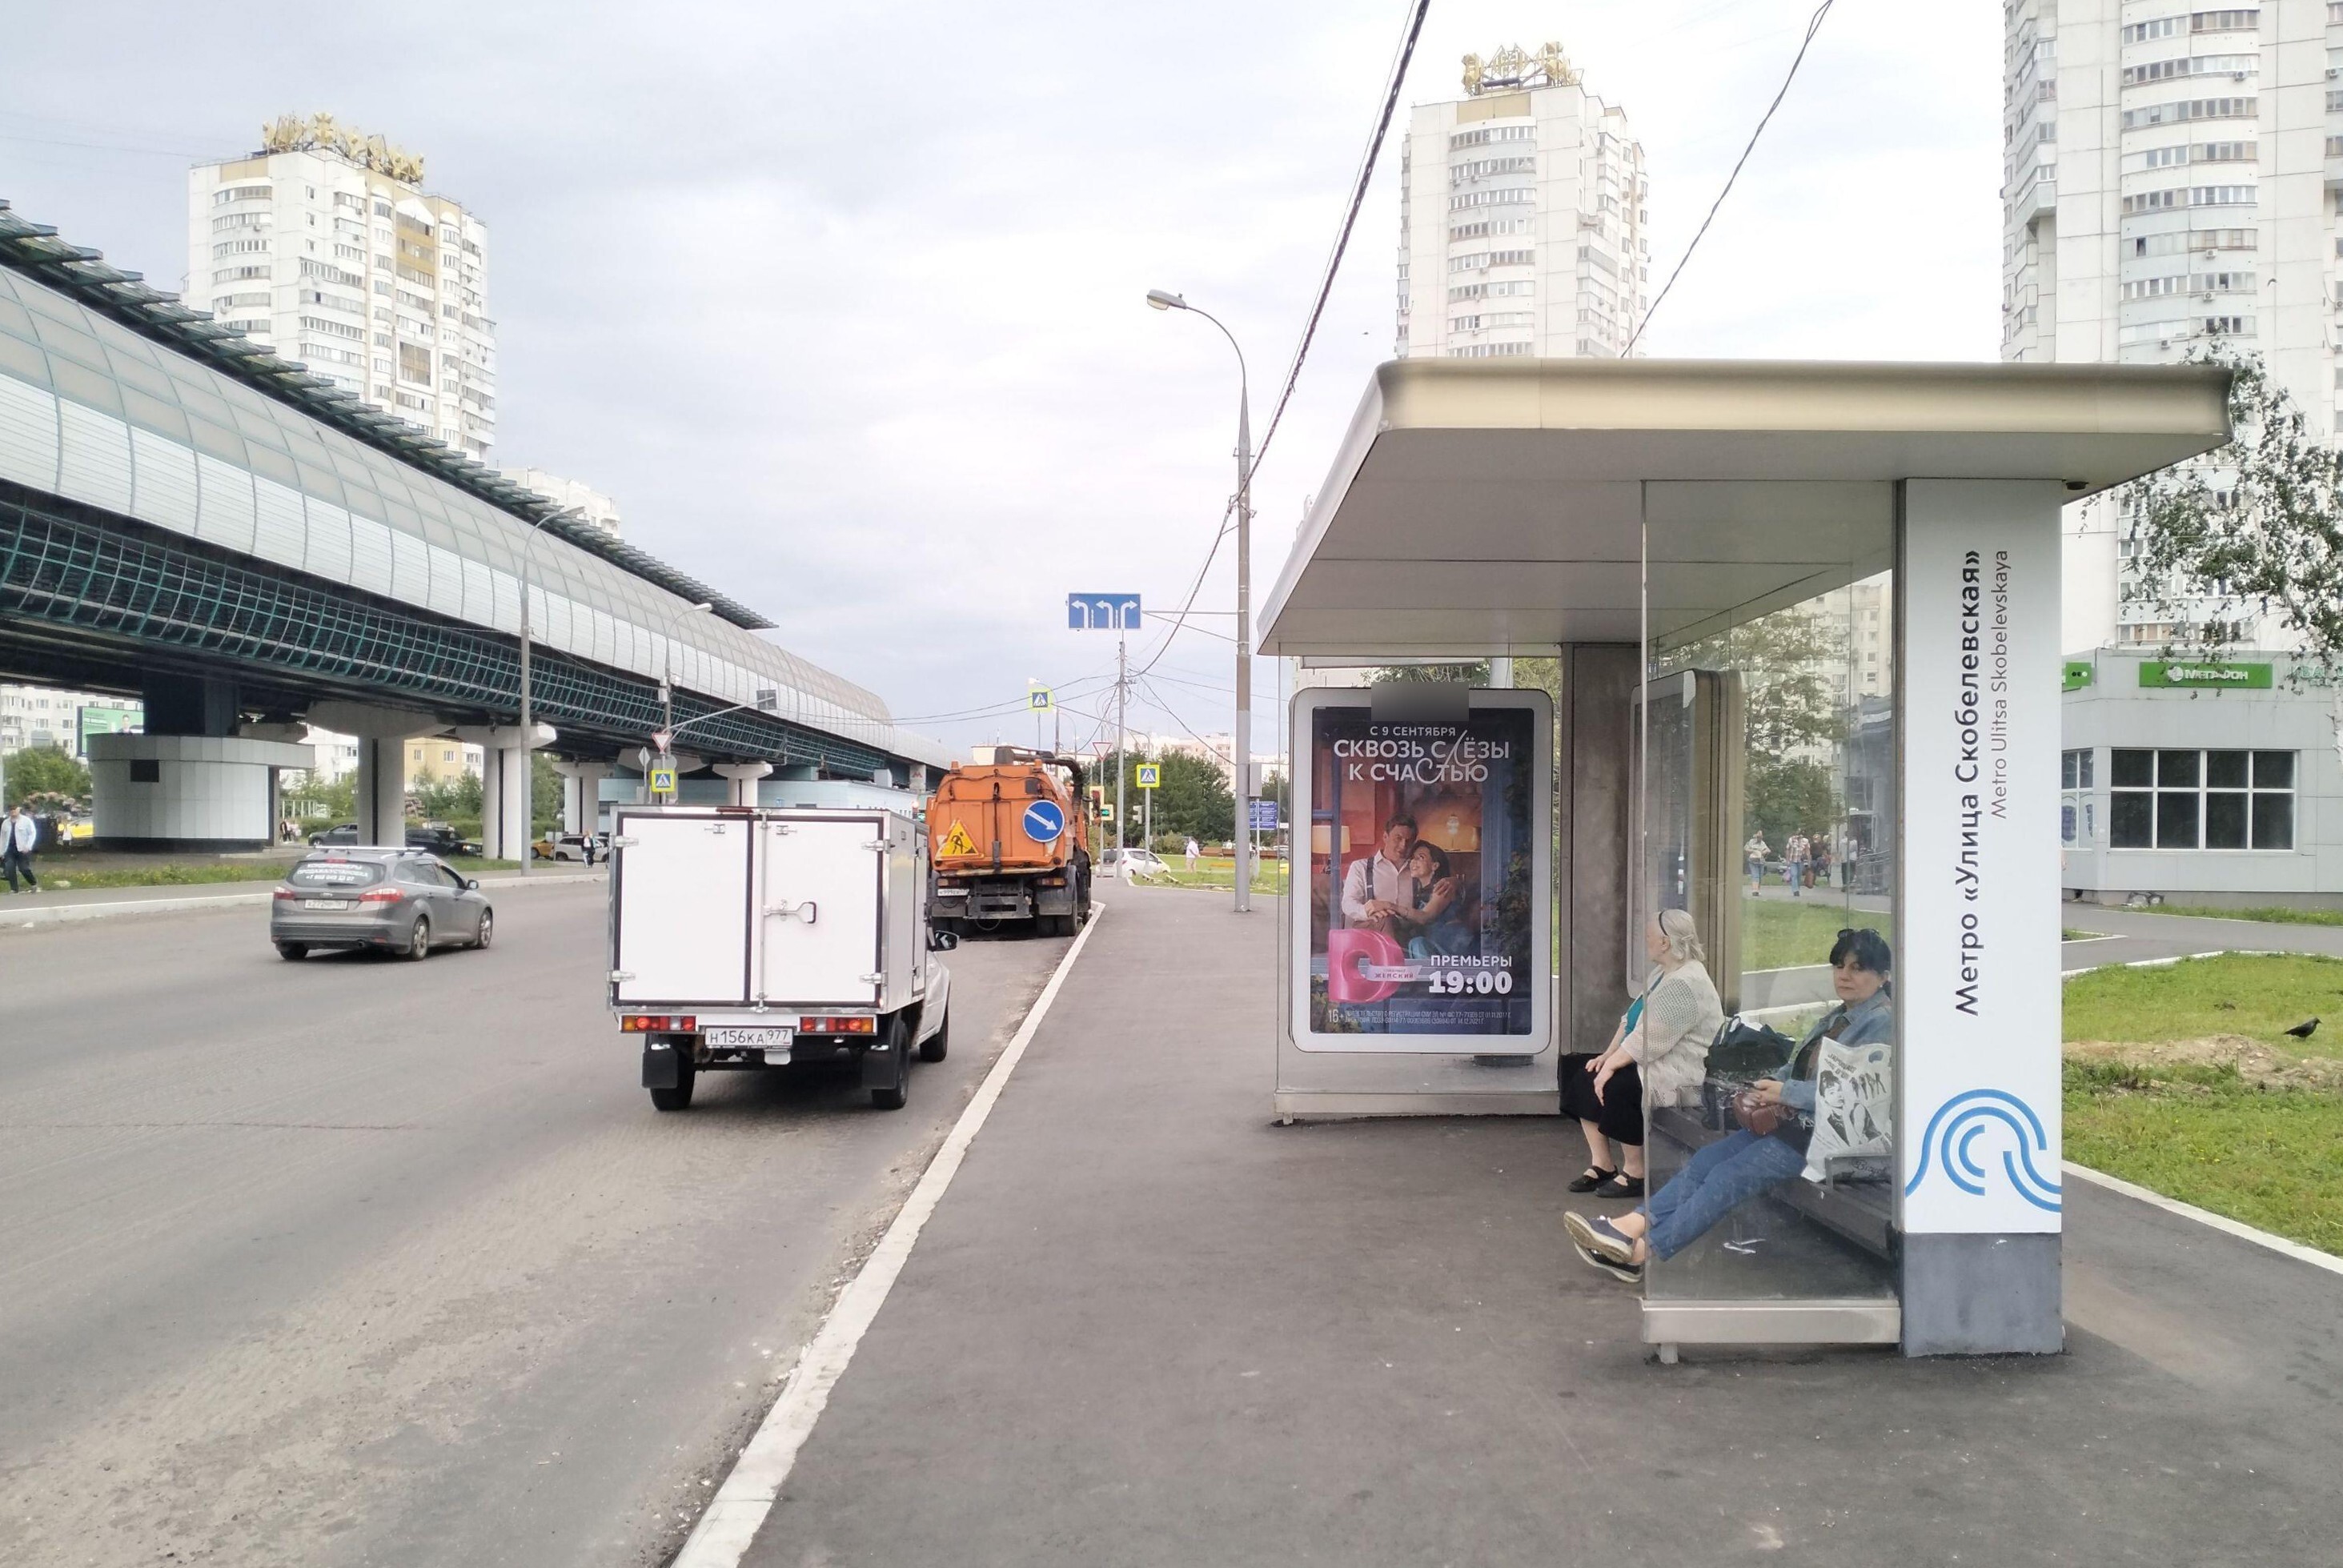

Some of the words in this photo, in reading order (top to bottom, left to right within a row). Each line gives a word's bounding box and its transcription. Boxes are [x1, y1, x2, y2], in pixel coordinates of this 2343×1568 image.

[1990, 549, 2012, 693] Skobelevskaya
[1955, 549, 1980, 783] Скобелевская»
[1370, 726, 1378, 736] С
[1382, 726, 1389, 736] 9
[1393, 726, 1456, 736] СЕНТЯБРЯ
[1990, 698, 2008, 752] Ulitsa
[1334, 739, 1425, 759] СКВОЗЬ
[1430, 730, 1509, 767] СЛЁЗЫ
[1349, 763, 1364, 781] К
[1370, 757, 1489, 784] СЧАСТЬЮ
[1991, 757, 2008, 820] Metro
[1955, 793, 1982, 902] «Улица
[1430, 954, 1512, 967] ПРЕМЬЕРЫ
[1955, 912, 1984, 1017] Метро
[1428, 970, 1513, 994] 19:00
[1328, 1009, 1344, 1024] 16+
[710, 1029, 764, 1044] Н156КА
[767, 1029, 788, 1041] 977
